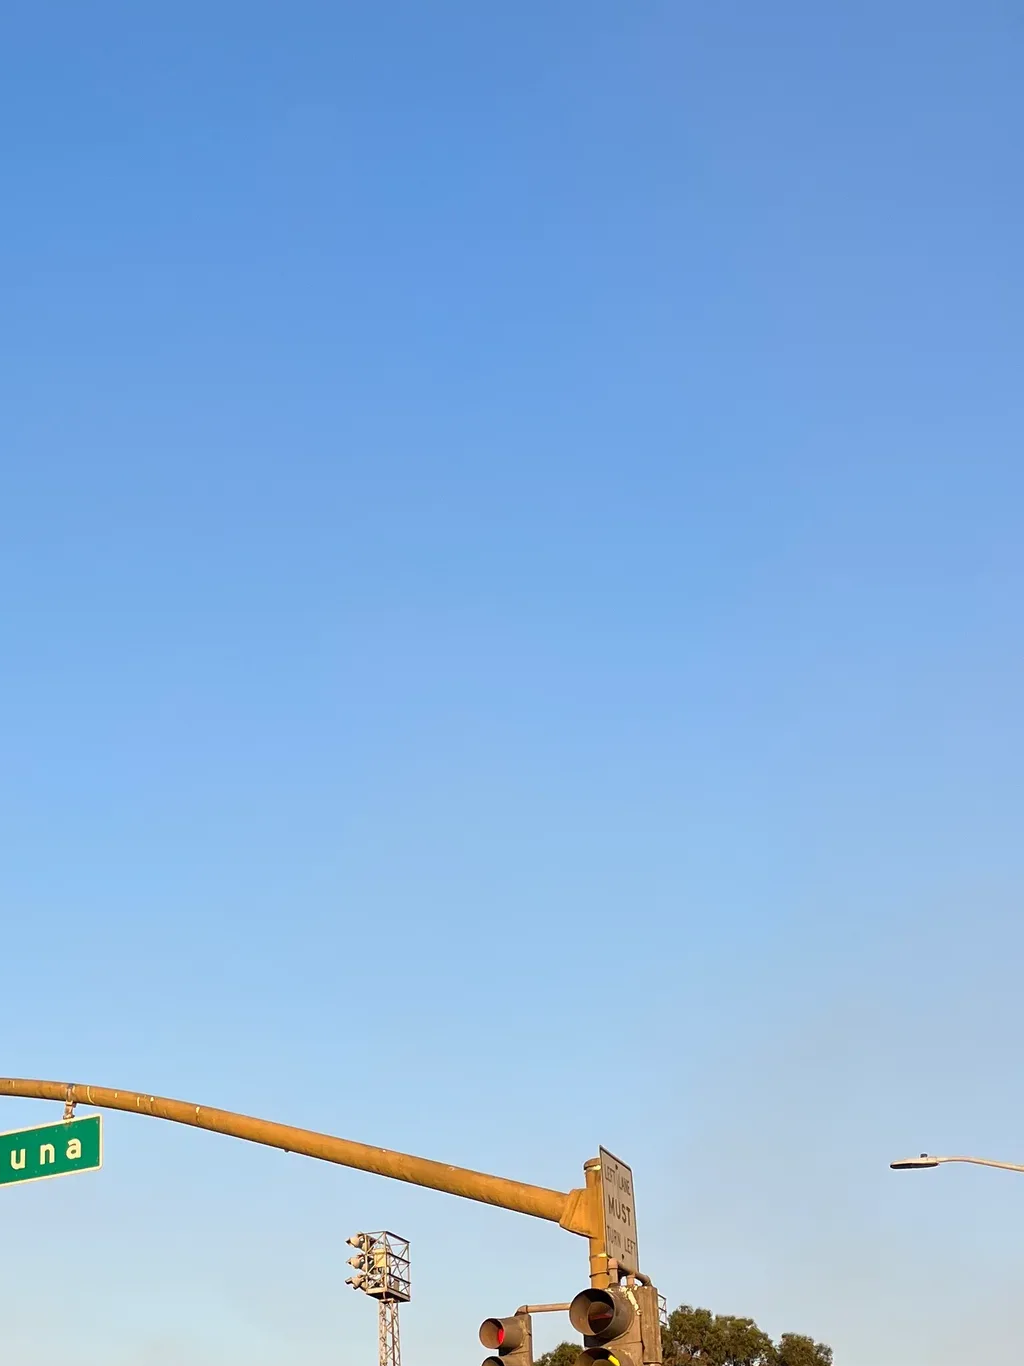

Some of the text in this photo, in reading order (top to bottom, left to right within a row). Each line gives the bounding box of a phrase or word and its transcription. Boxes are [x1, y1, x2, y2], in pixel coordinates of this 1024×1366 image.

[604, 1163, 631, 1196] LEFT LANE
[608, 1194, 632, 1226] MUST
[607, 1225, 636, 1255] TURN LEFT
